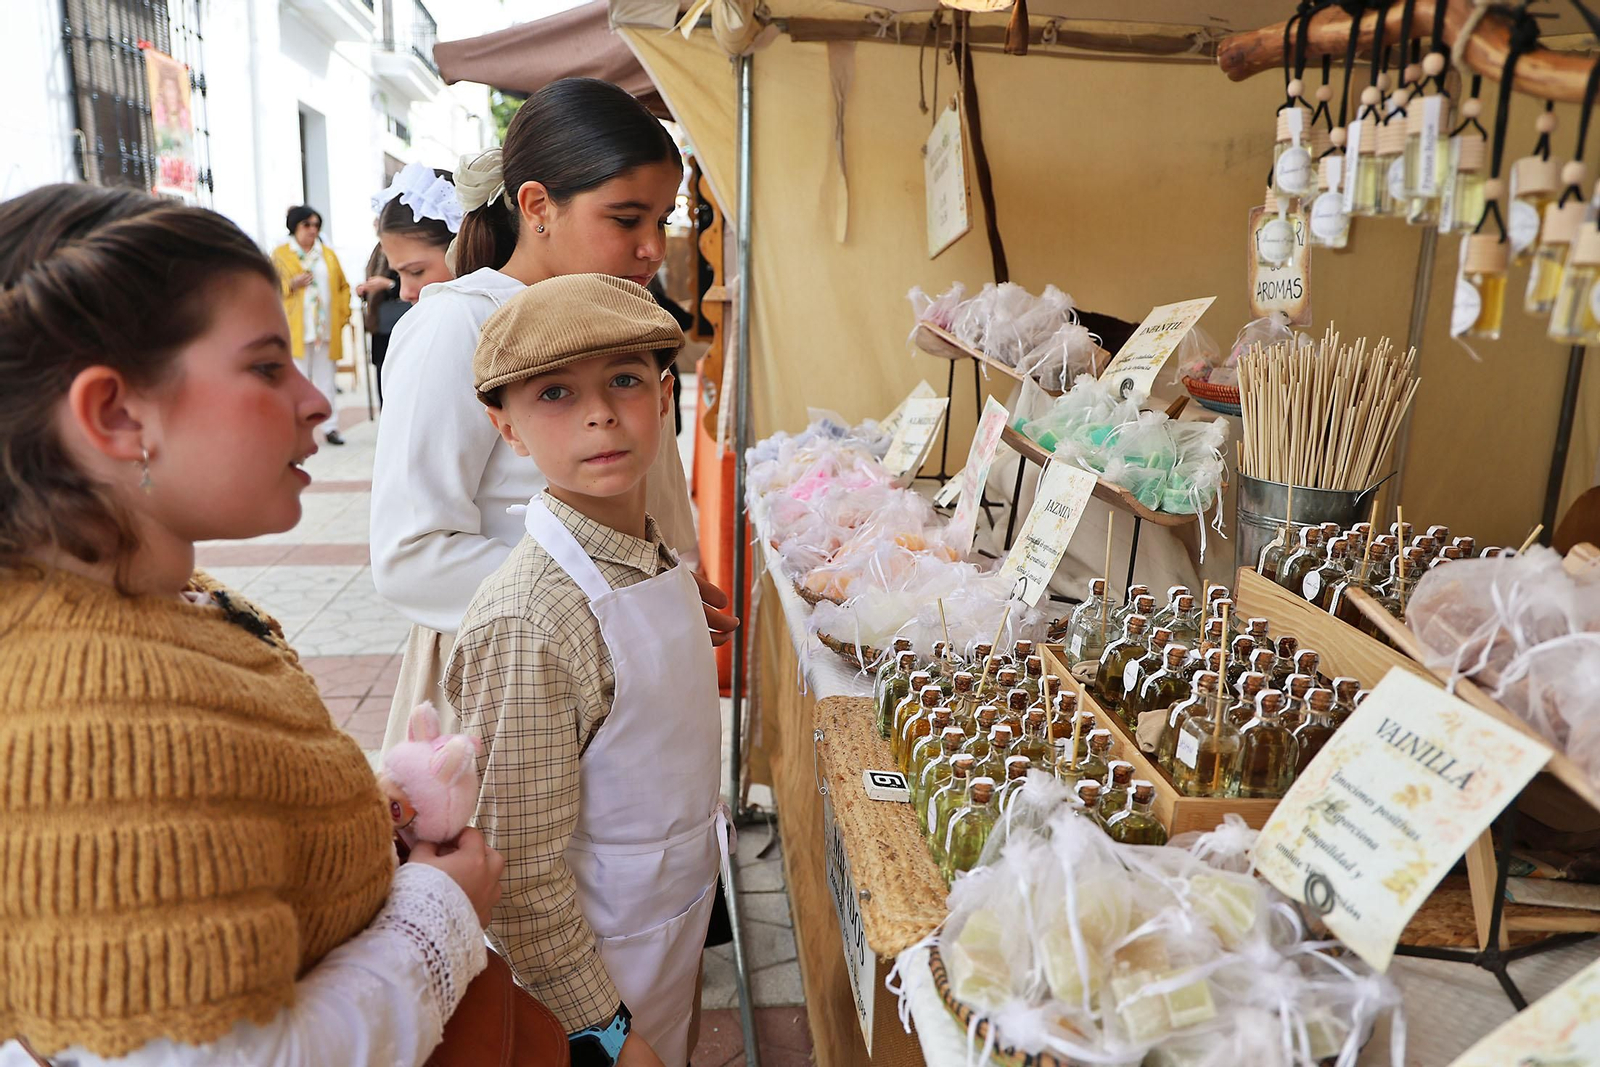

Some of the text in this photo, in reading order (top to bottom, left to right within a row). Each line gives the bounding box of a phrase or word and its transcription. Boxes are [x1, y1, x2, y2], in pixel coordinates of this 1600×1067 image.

[1256, 278, 1303, 302] AROMAS
[1139, 321, 1182, 336] INFANTIL
[1044, 499, 1073, 520] JAZMIN
[1374, 717, 1476, 792] VAINILLA
[1331, 768, 1422, 842] Emociones positivas
[1275, 842, 1303, 869] combate
[1301, 825, 1364, 881] tranquilidad y
